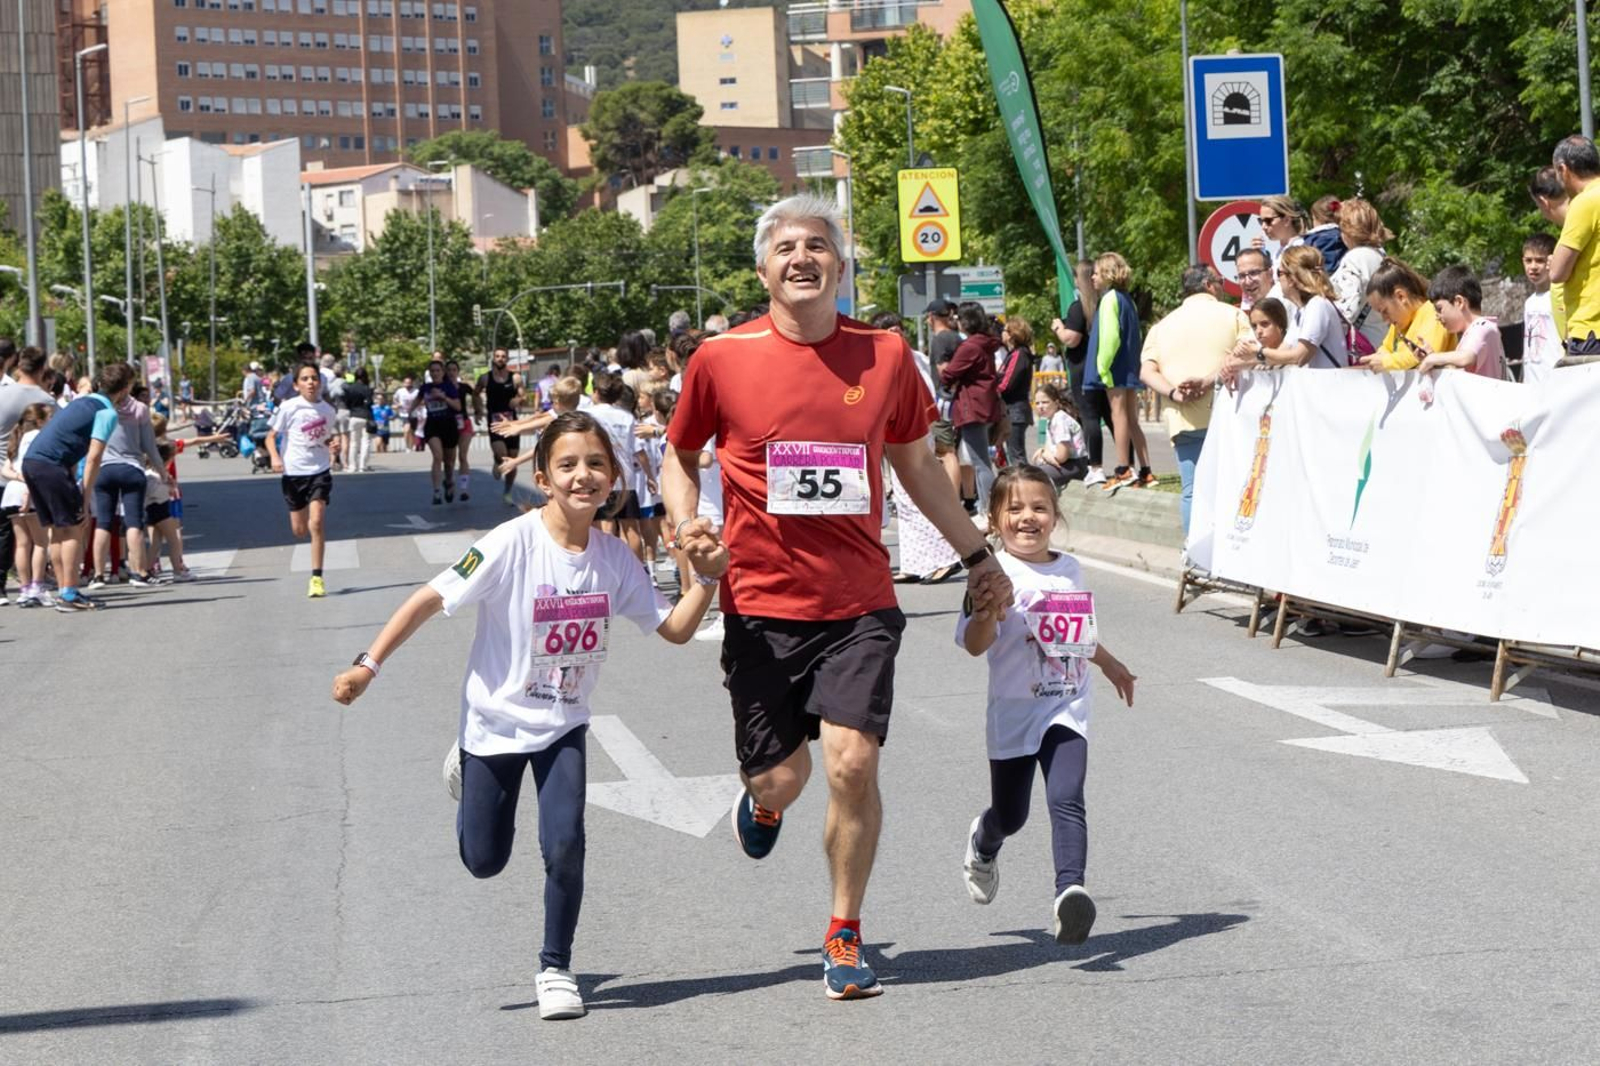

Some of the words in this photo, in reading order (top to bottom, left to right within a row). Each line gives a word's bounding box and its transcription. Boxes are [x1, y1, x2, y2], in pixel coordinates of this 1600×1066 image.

[901, 171, 954, 180] ATENCION
[921, 232, 941, 243] 20
[772, 443, 810, 455] XXVII
[797, 469, 842, 498] 55
[545, 621, 598, 654] 696
[1039, 615, 1083, 643] 697
